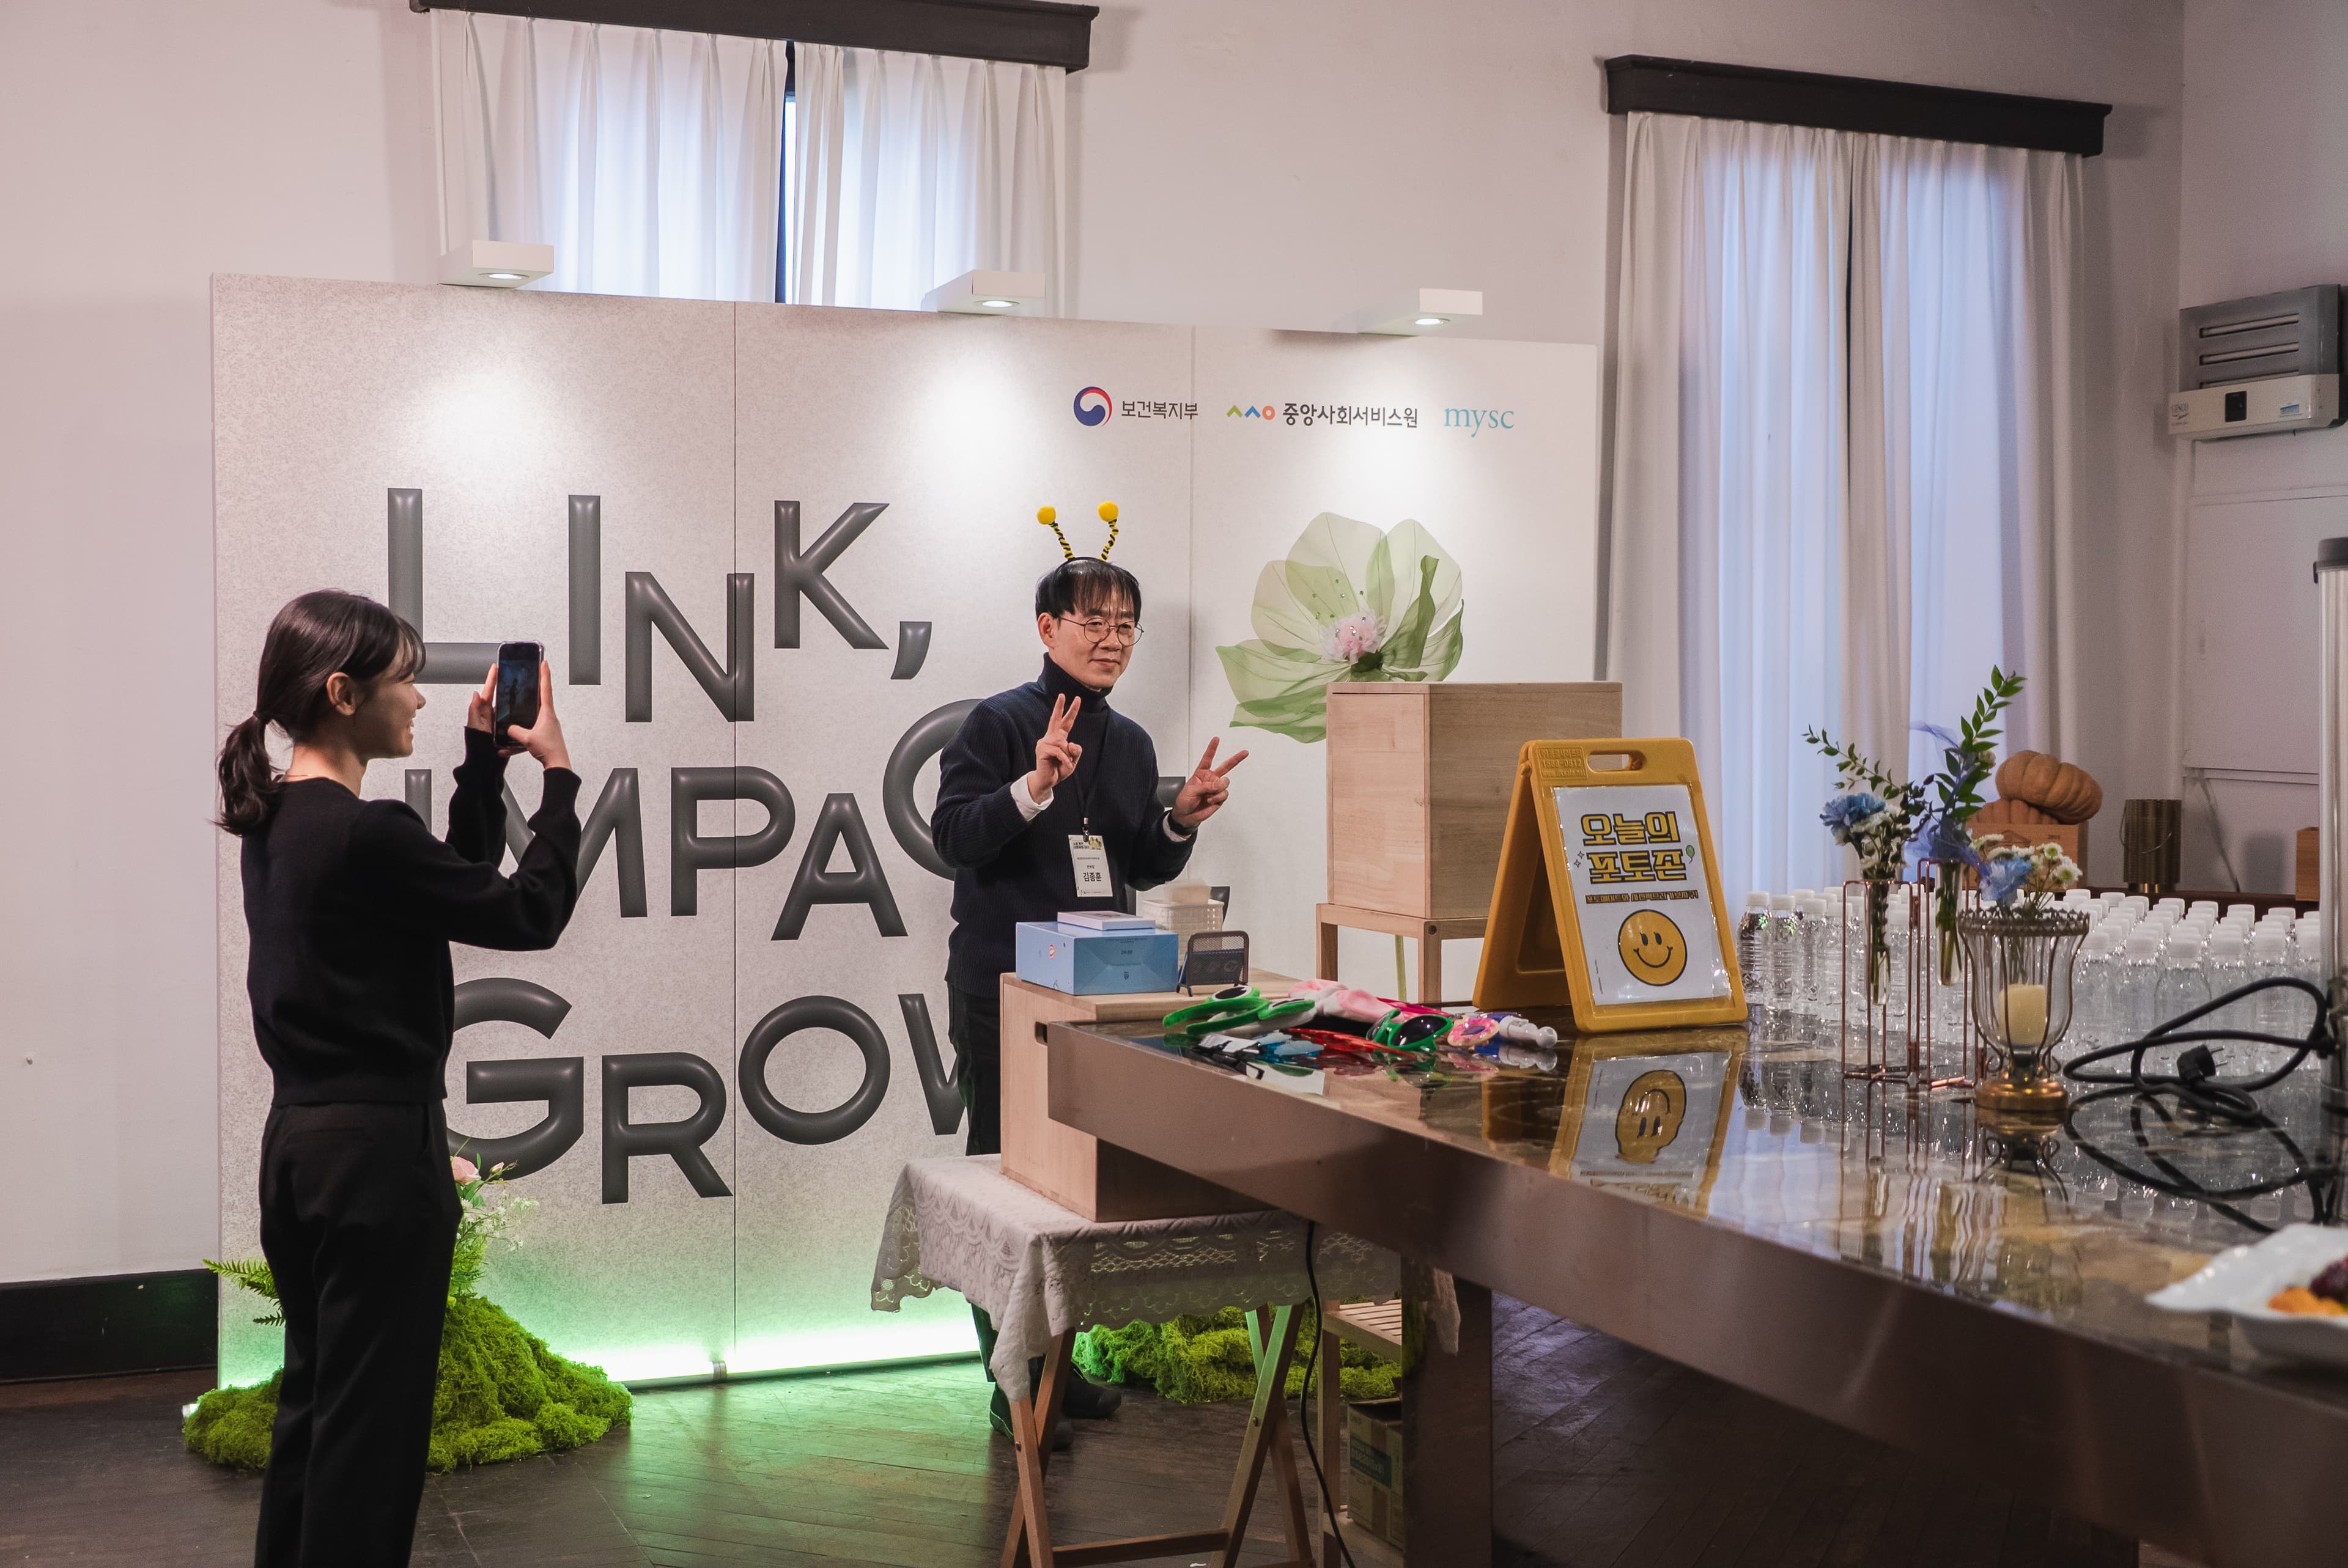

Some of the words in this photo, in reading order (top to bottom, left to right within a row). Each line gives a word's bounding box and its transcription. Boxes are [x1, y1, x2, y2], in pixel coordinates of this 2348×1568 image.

[1120, 400, 1198, 420] 보건복지부
[1282, 403, 1418, 428] 중앙사회서비스원
[1444, 404, 1515, 437] mysc
[1542, 759, 1582, 768] 1588-0812
[1580, 811, 1680, 846] 오늘의
[1083, 872, 1102, 882] 김종훈
[1586, 848, 1687, 884] 포토존
